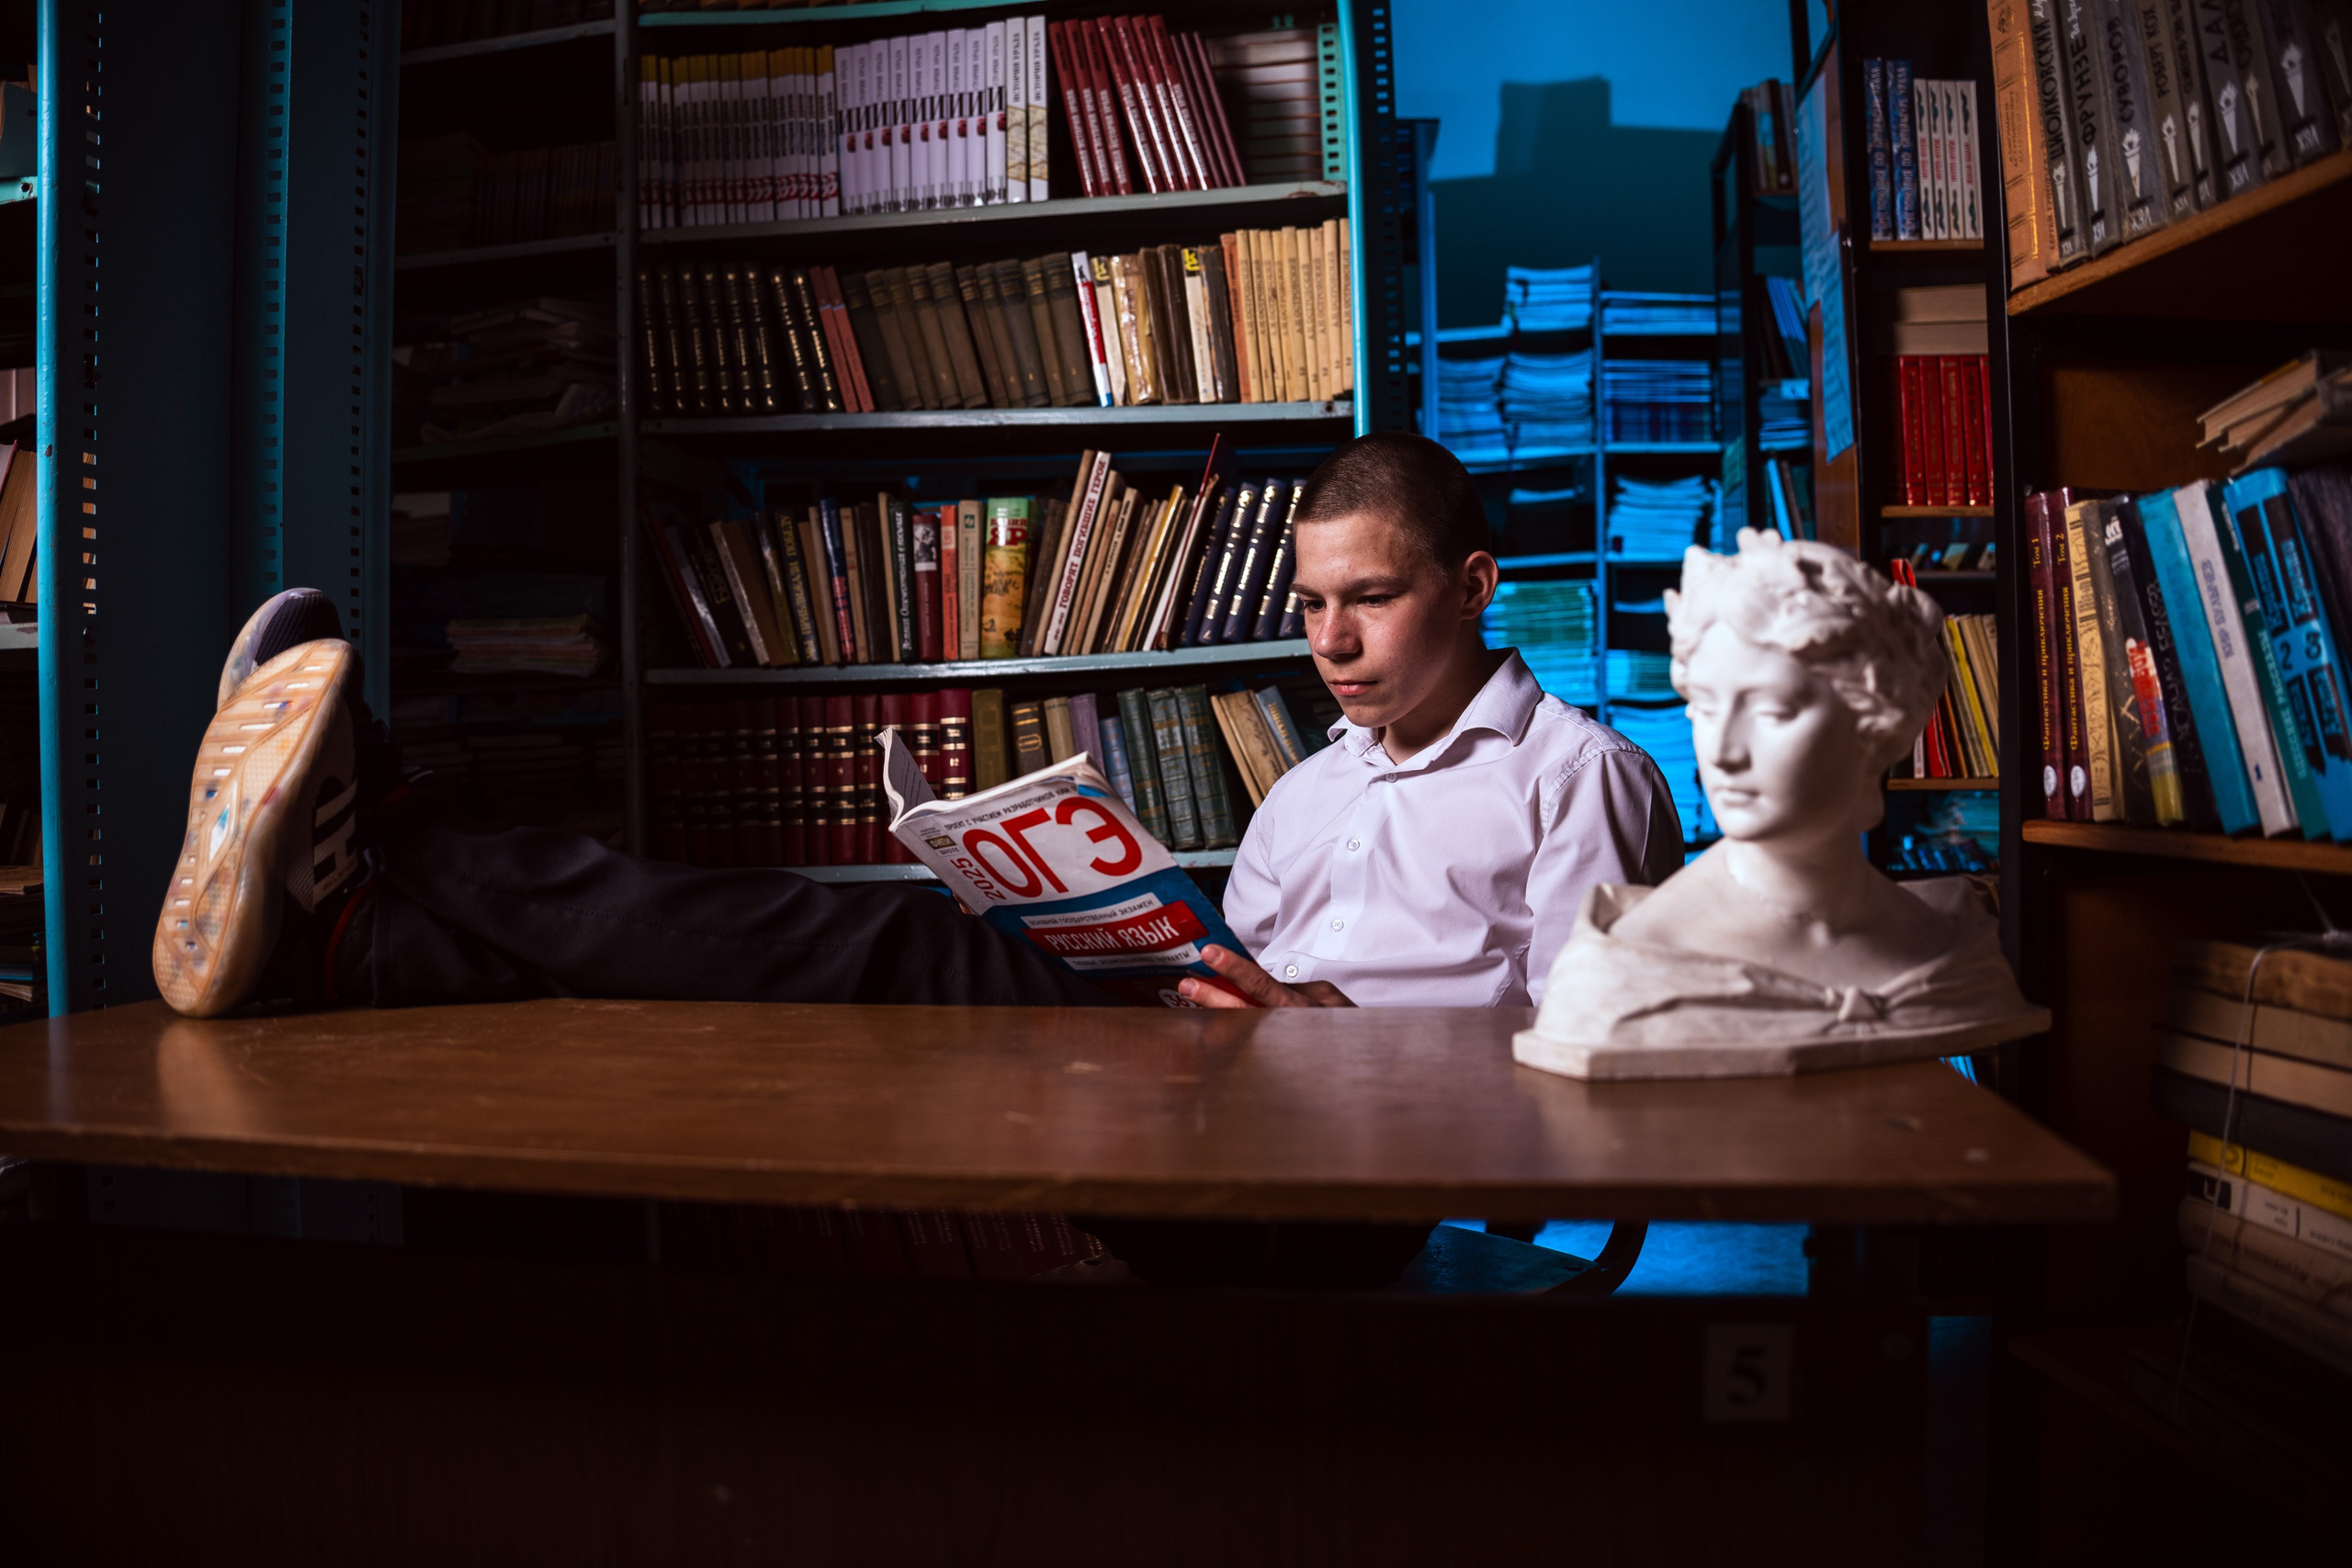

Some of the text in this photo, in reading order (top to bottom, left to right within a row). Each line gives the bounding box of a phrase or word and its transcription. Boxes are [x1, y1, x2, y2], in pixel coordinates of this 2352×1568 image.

[2109, 17, 2134, 123] СУВОРОВ
[2142, 8, 2169, 97] РОБЕРТ КОХ
[2032, 18, 2066, 160] ЦИОЛКОВСКИЙ
[2069, 33, 2098, 145] ФРУНЗЕ
[779, 513, 797, 557] ПОБЕДУ
[1060, 560, 1079, 608] ГОВОРЯТ
[1073, 497, 1096, 558] ПОГИБШИЕ
[1090, 459, 1106, 493] ГЕРОИ
[2032, 545, 2041, 569] Том
[2055, 532, 2066, 566] Том 2
[2037, 589, 2049, 667] приключения
[2062, 586, 2075, 664] приключения
[2200, 558, 2234, 660] КИР БУЛЫЧЕВ
[2279, 641, 2291, 671] 2
[2042, 680, 2051, 750] Фантастика
[2069, 676, 2078, 750] Фантастика
[944, 818, 965, 831] ПРОЕКТ
[972, 810, 1001, 825] УЧАСТИЕМ
[1002, 791, 1055, 814] РАЗРАБОТЧИКОВ
[1056, 786, 1069, 796] КИМ
[950, 857, 1007, 900] 2025
[963, 796, 1142, 897] ОГЭ
[1045, 916, 1180, 951] РУССКИЙ ЯЗЫК
[1058, 910, 1118, 924] ГОСУДАРСТВЕННЫЙ
[1118, 900, 1155, 914] ЭКЗАМЕН
[1156, 952, 1190, 964] ВАРИАНТЫ
[1163, 994, 1191, 1008] 36
[1729, 1347, 1767, 1406] 5
